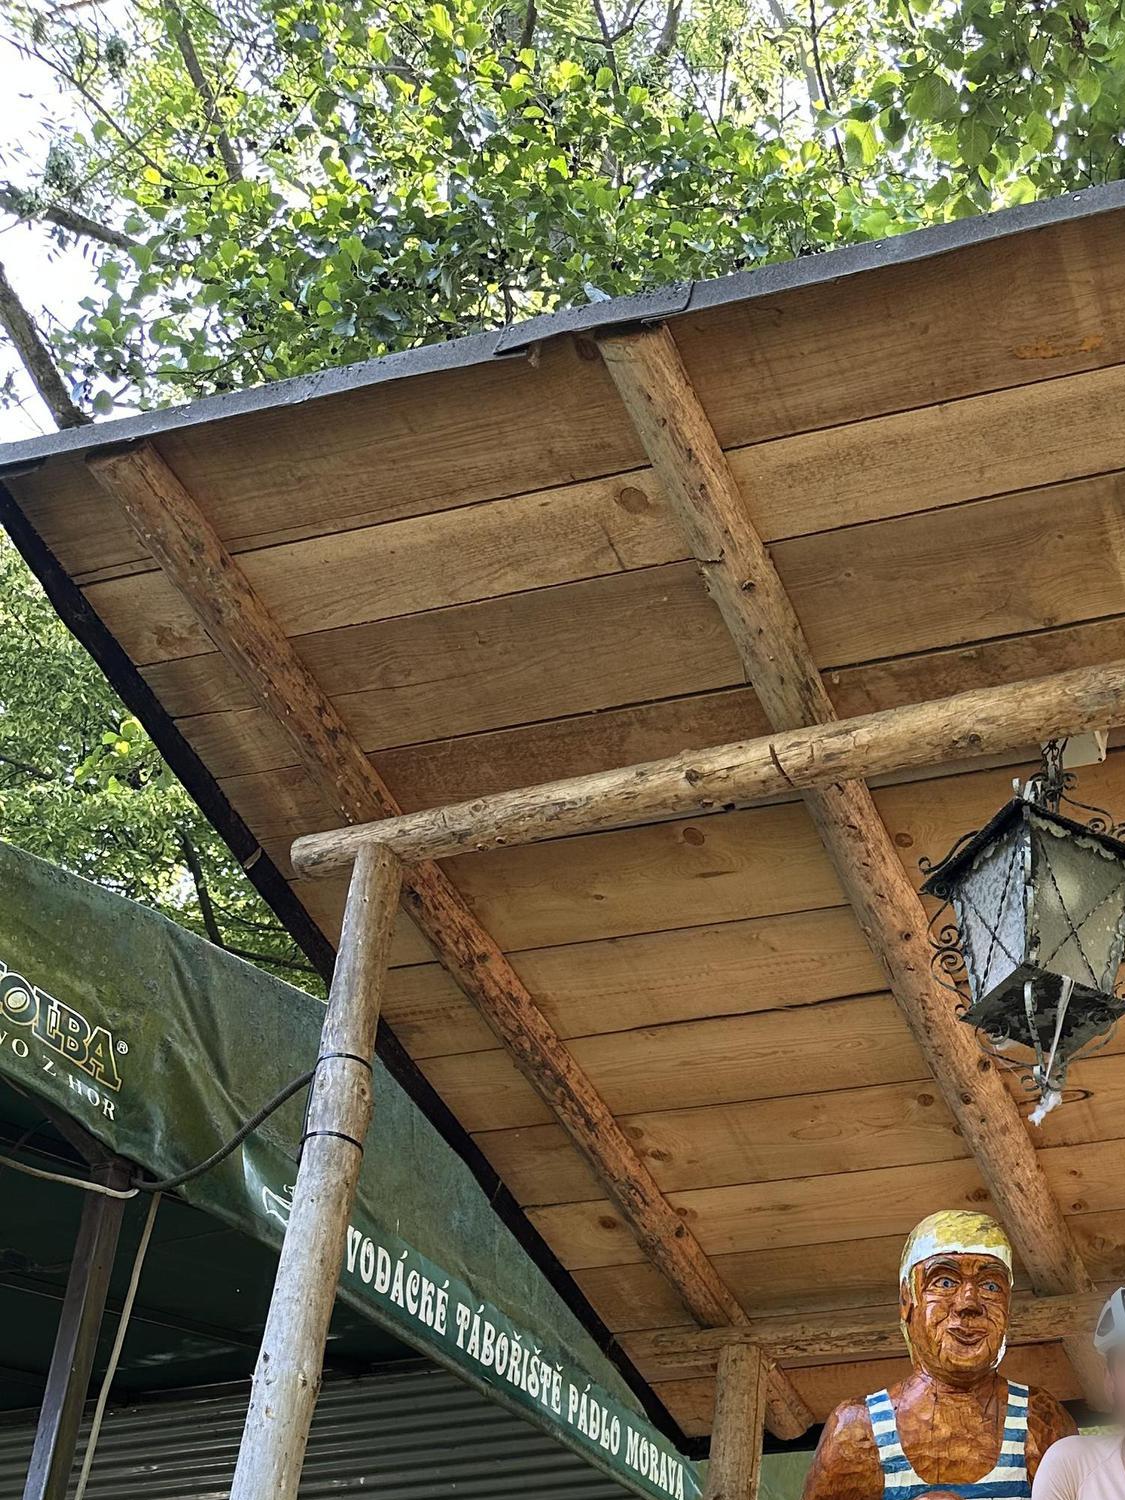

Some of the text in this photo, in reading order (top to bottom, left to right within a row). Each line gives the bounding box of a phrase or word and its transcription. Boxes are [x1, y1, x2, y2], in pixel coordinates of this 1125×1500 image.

[0, 961, 124, 1093] OLBA
[42, 1055, 57, 1076] Z
[68, 1074, 115, 1121] HOR
[346, 1225, 450, 1336] VODÁCKÉ
[456, 1302, 563, 1416] TÁBOŘIŠTĚ
[567, 1383, 621, 1456] PÁDLO
